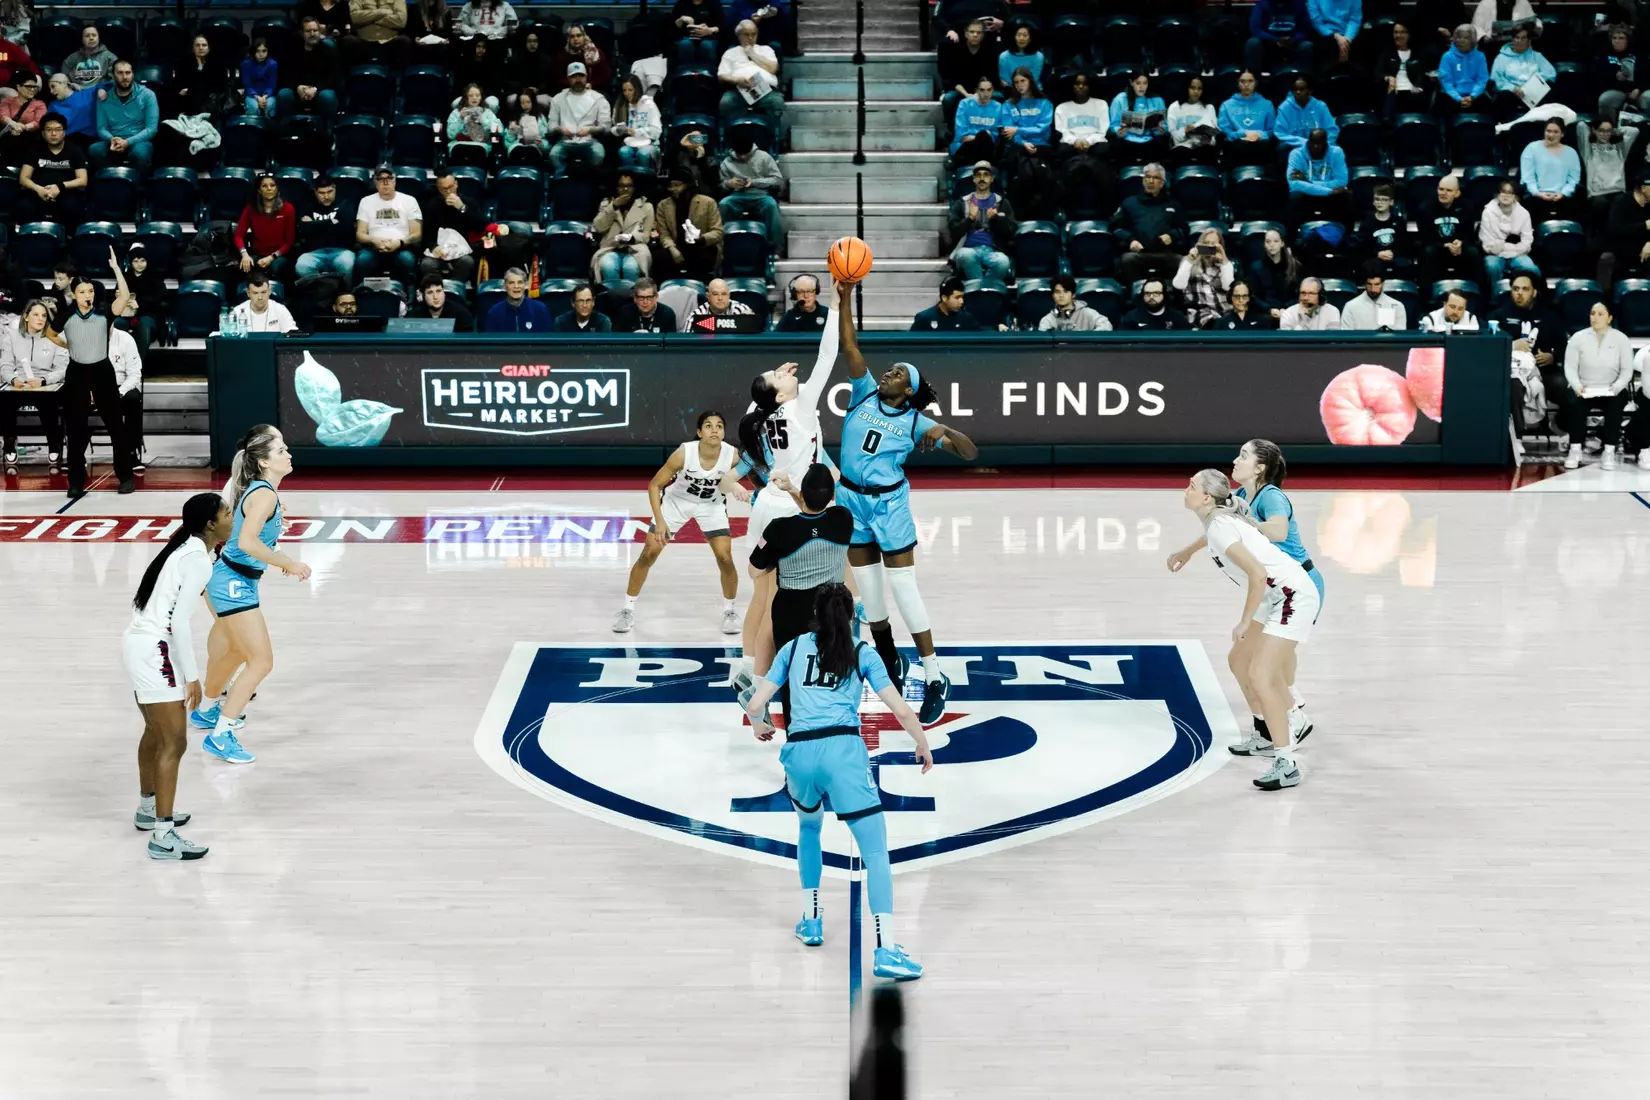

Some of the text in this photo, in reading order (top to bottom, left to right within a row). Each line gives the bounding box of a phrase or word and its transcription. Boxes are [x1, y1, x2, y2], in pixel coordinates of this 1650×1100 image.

[716, 318, 737, 329] POSS.
[501, 364, 551, 377] GIANT
[431, 378, 618, 407] HEIRLOOM
[1001, 381, 1167, 417] FINDS
[481, 409, 573, 423] MARKET
[857, 410, 904, 437] COLUMBIA
[765, 418, 790, 450] 25
[861, 428, 883, 456] 0
[686, 483, 716, 499] 22
[0, 518, 183, 540] IGH
[228, 580, 243, 599] C
[581, 656, 1135, 688] PN
